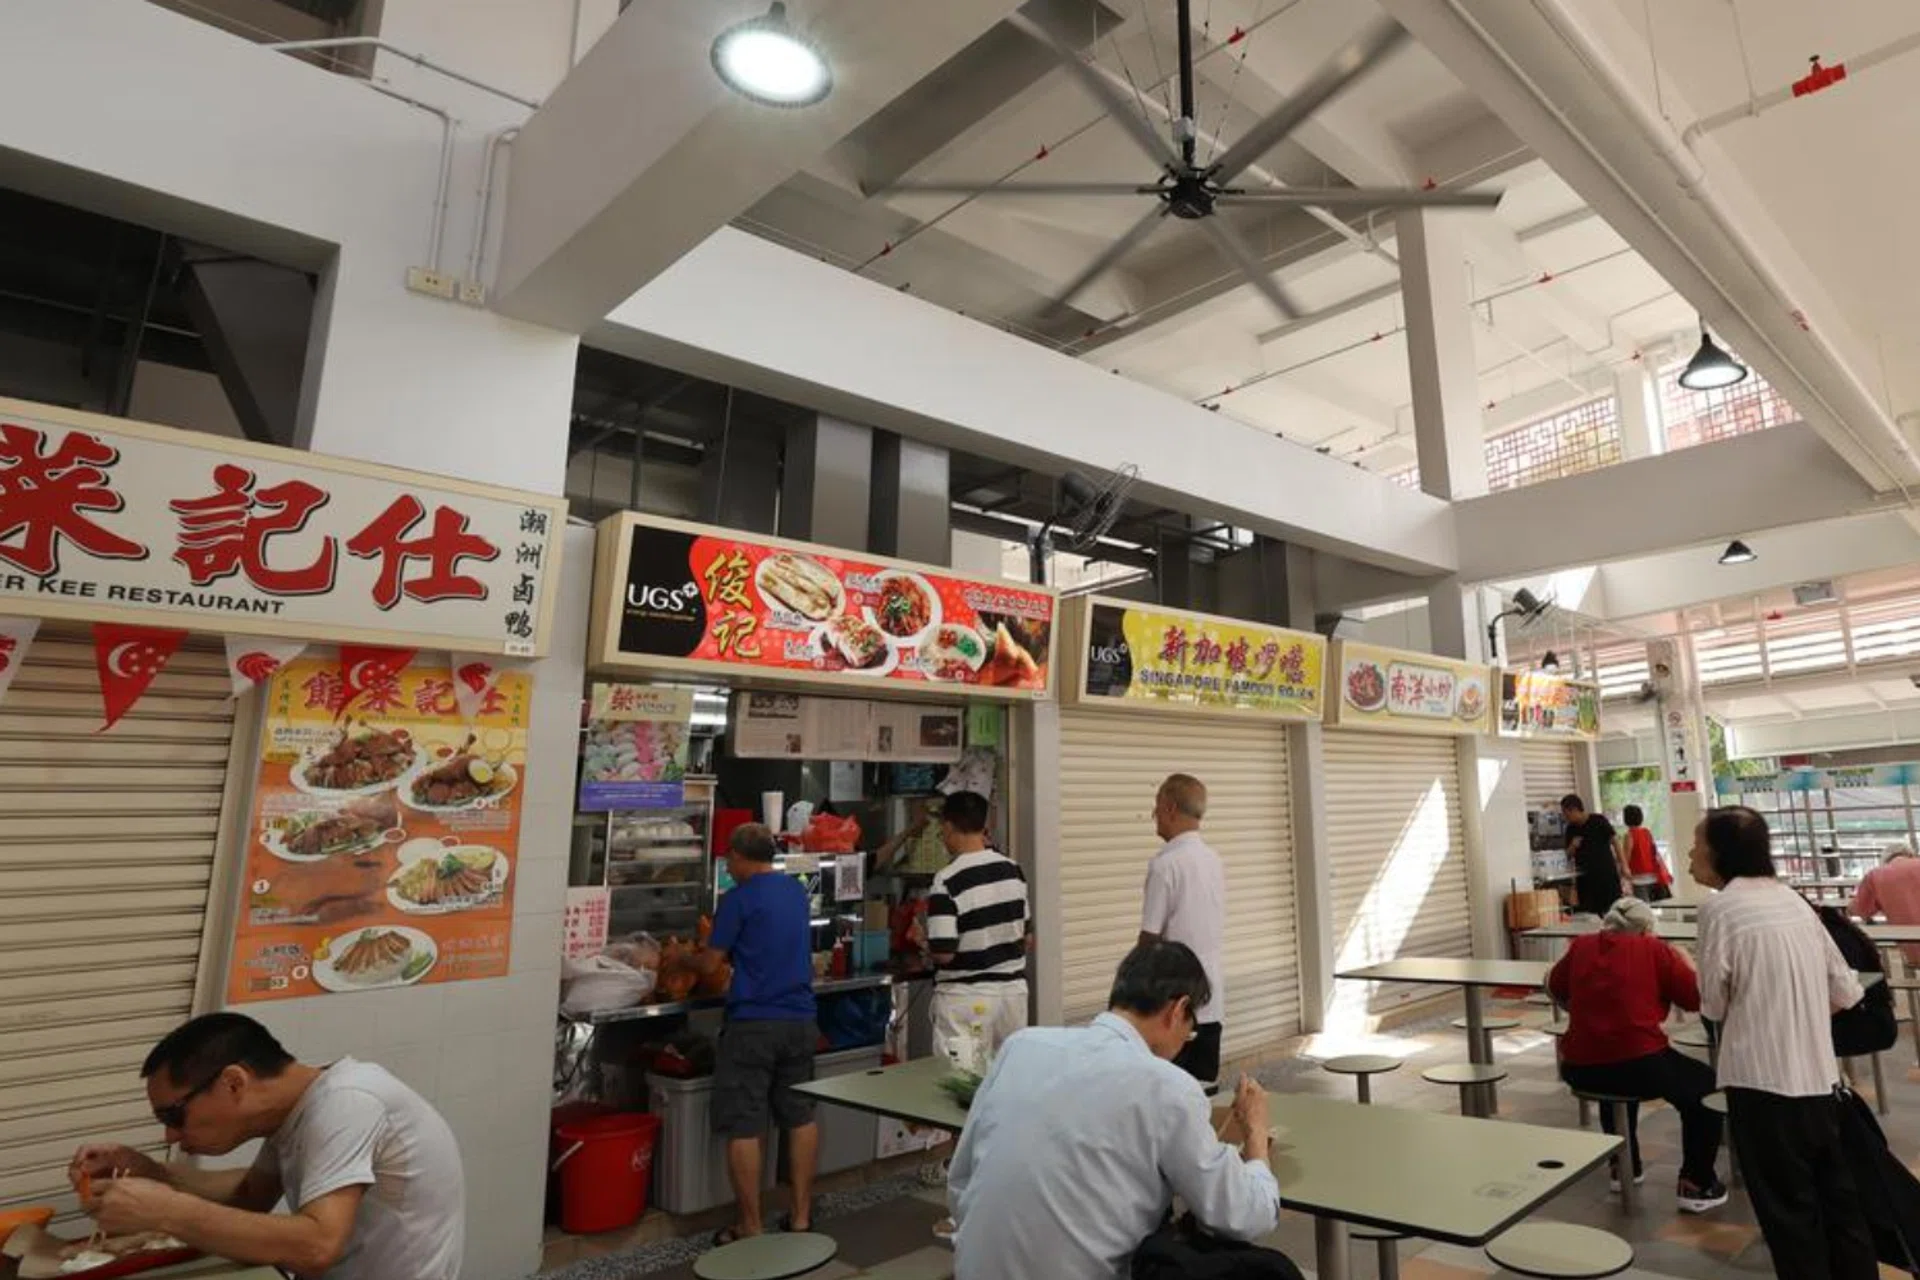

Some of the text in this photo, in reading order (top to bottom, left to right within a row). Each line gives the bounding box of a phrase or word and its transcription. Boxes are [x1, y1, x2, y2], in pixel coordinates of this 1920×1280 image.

[38, 577, 97, 597] KEE
[108, 585, 285, 614] RESTAURANT
[1140, 669, 1221, 691] SINGAPORE
